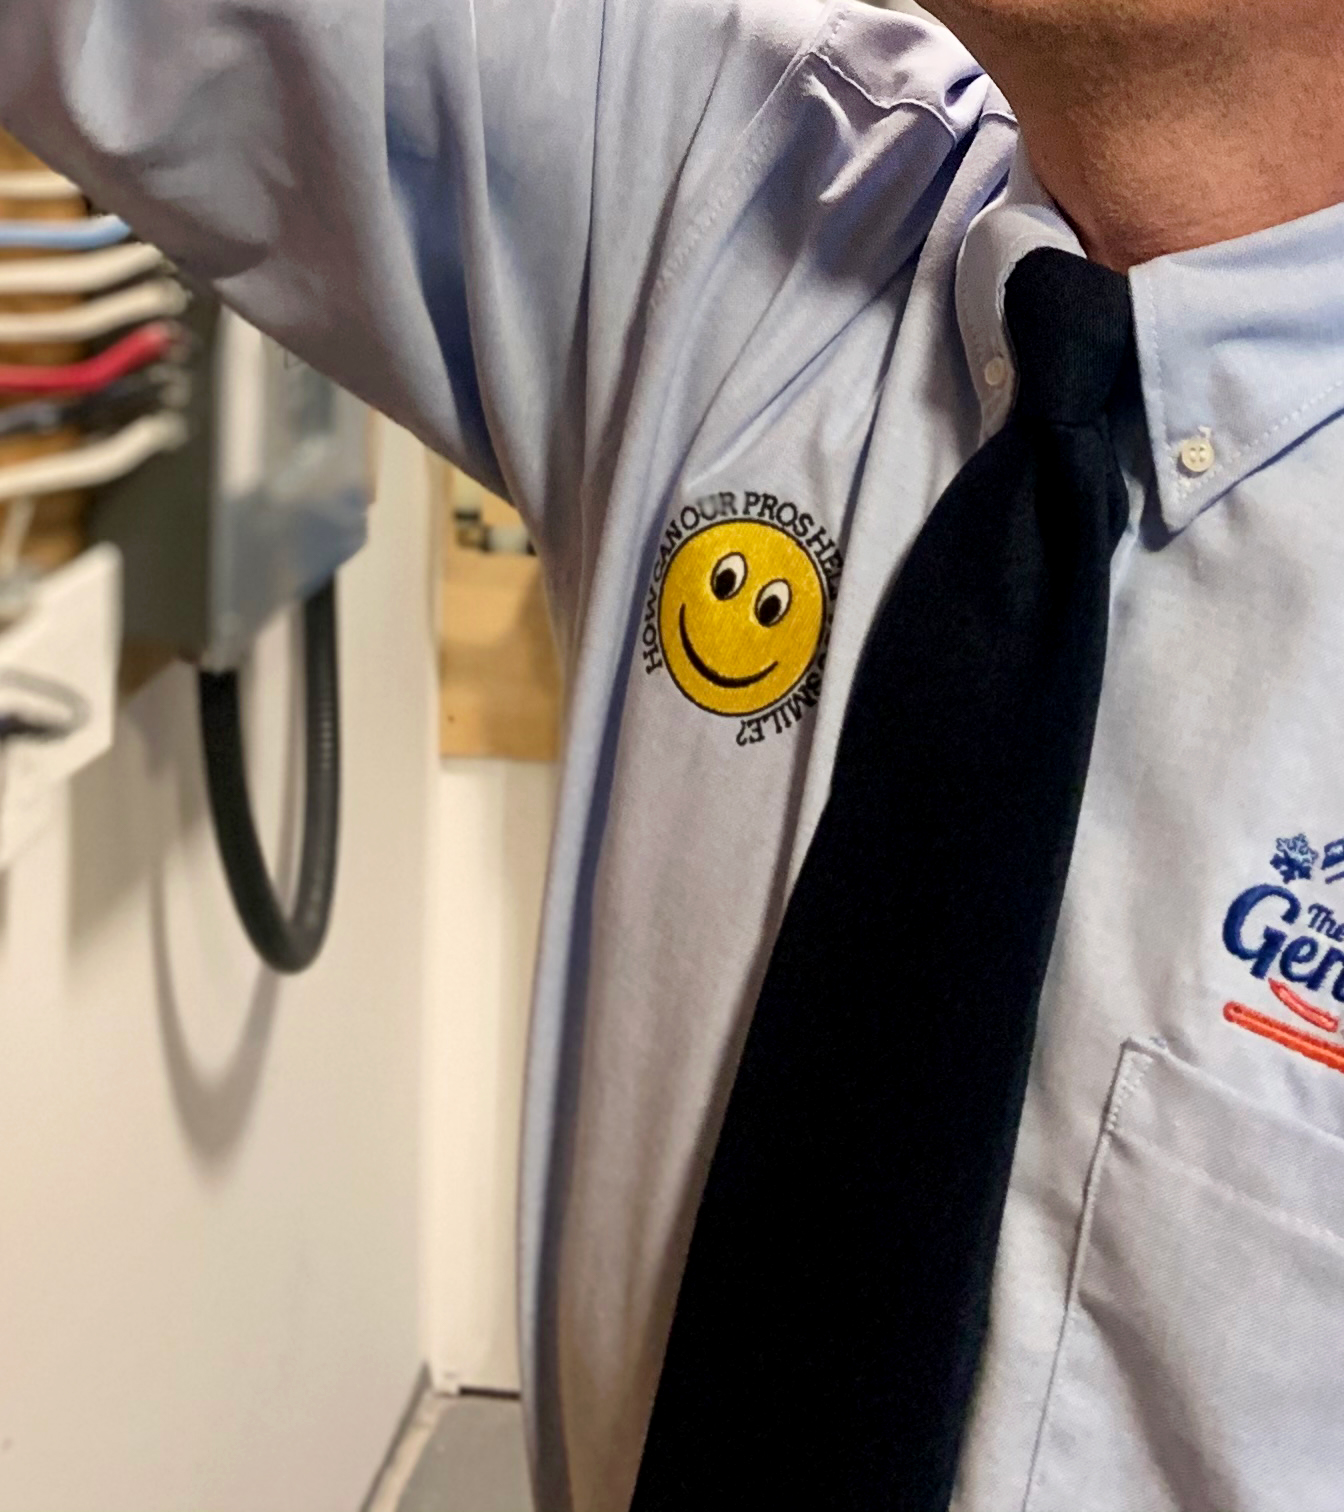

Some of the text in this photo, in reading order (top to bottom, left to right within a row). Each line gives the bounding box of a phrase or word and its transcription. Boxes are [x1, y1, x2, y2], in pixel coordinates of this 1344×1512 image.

[642, 490, 844, 747] HOW CAN OUR PROS HEL SMILE?
